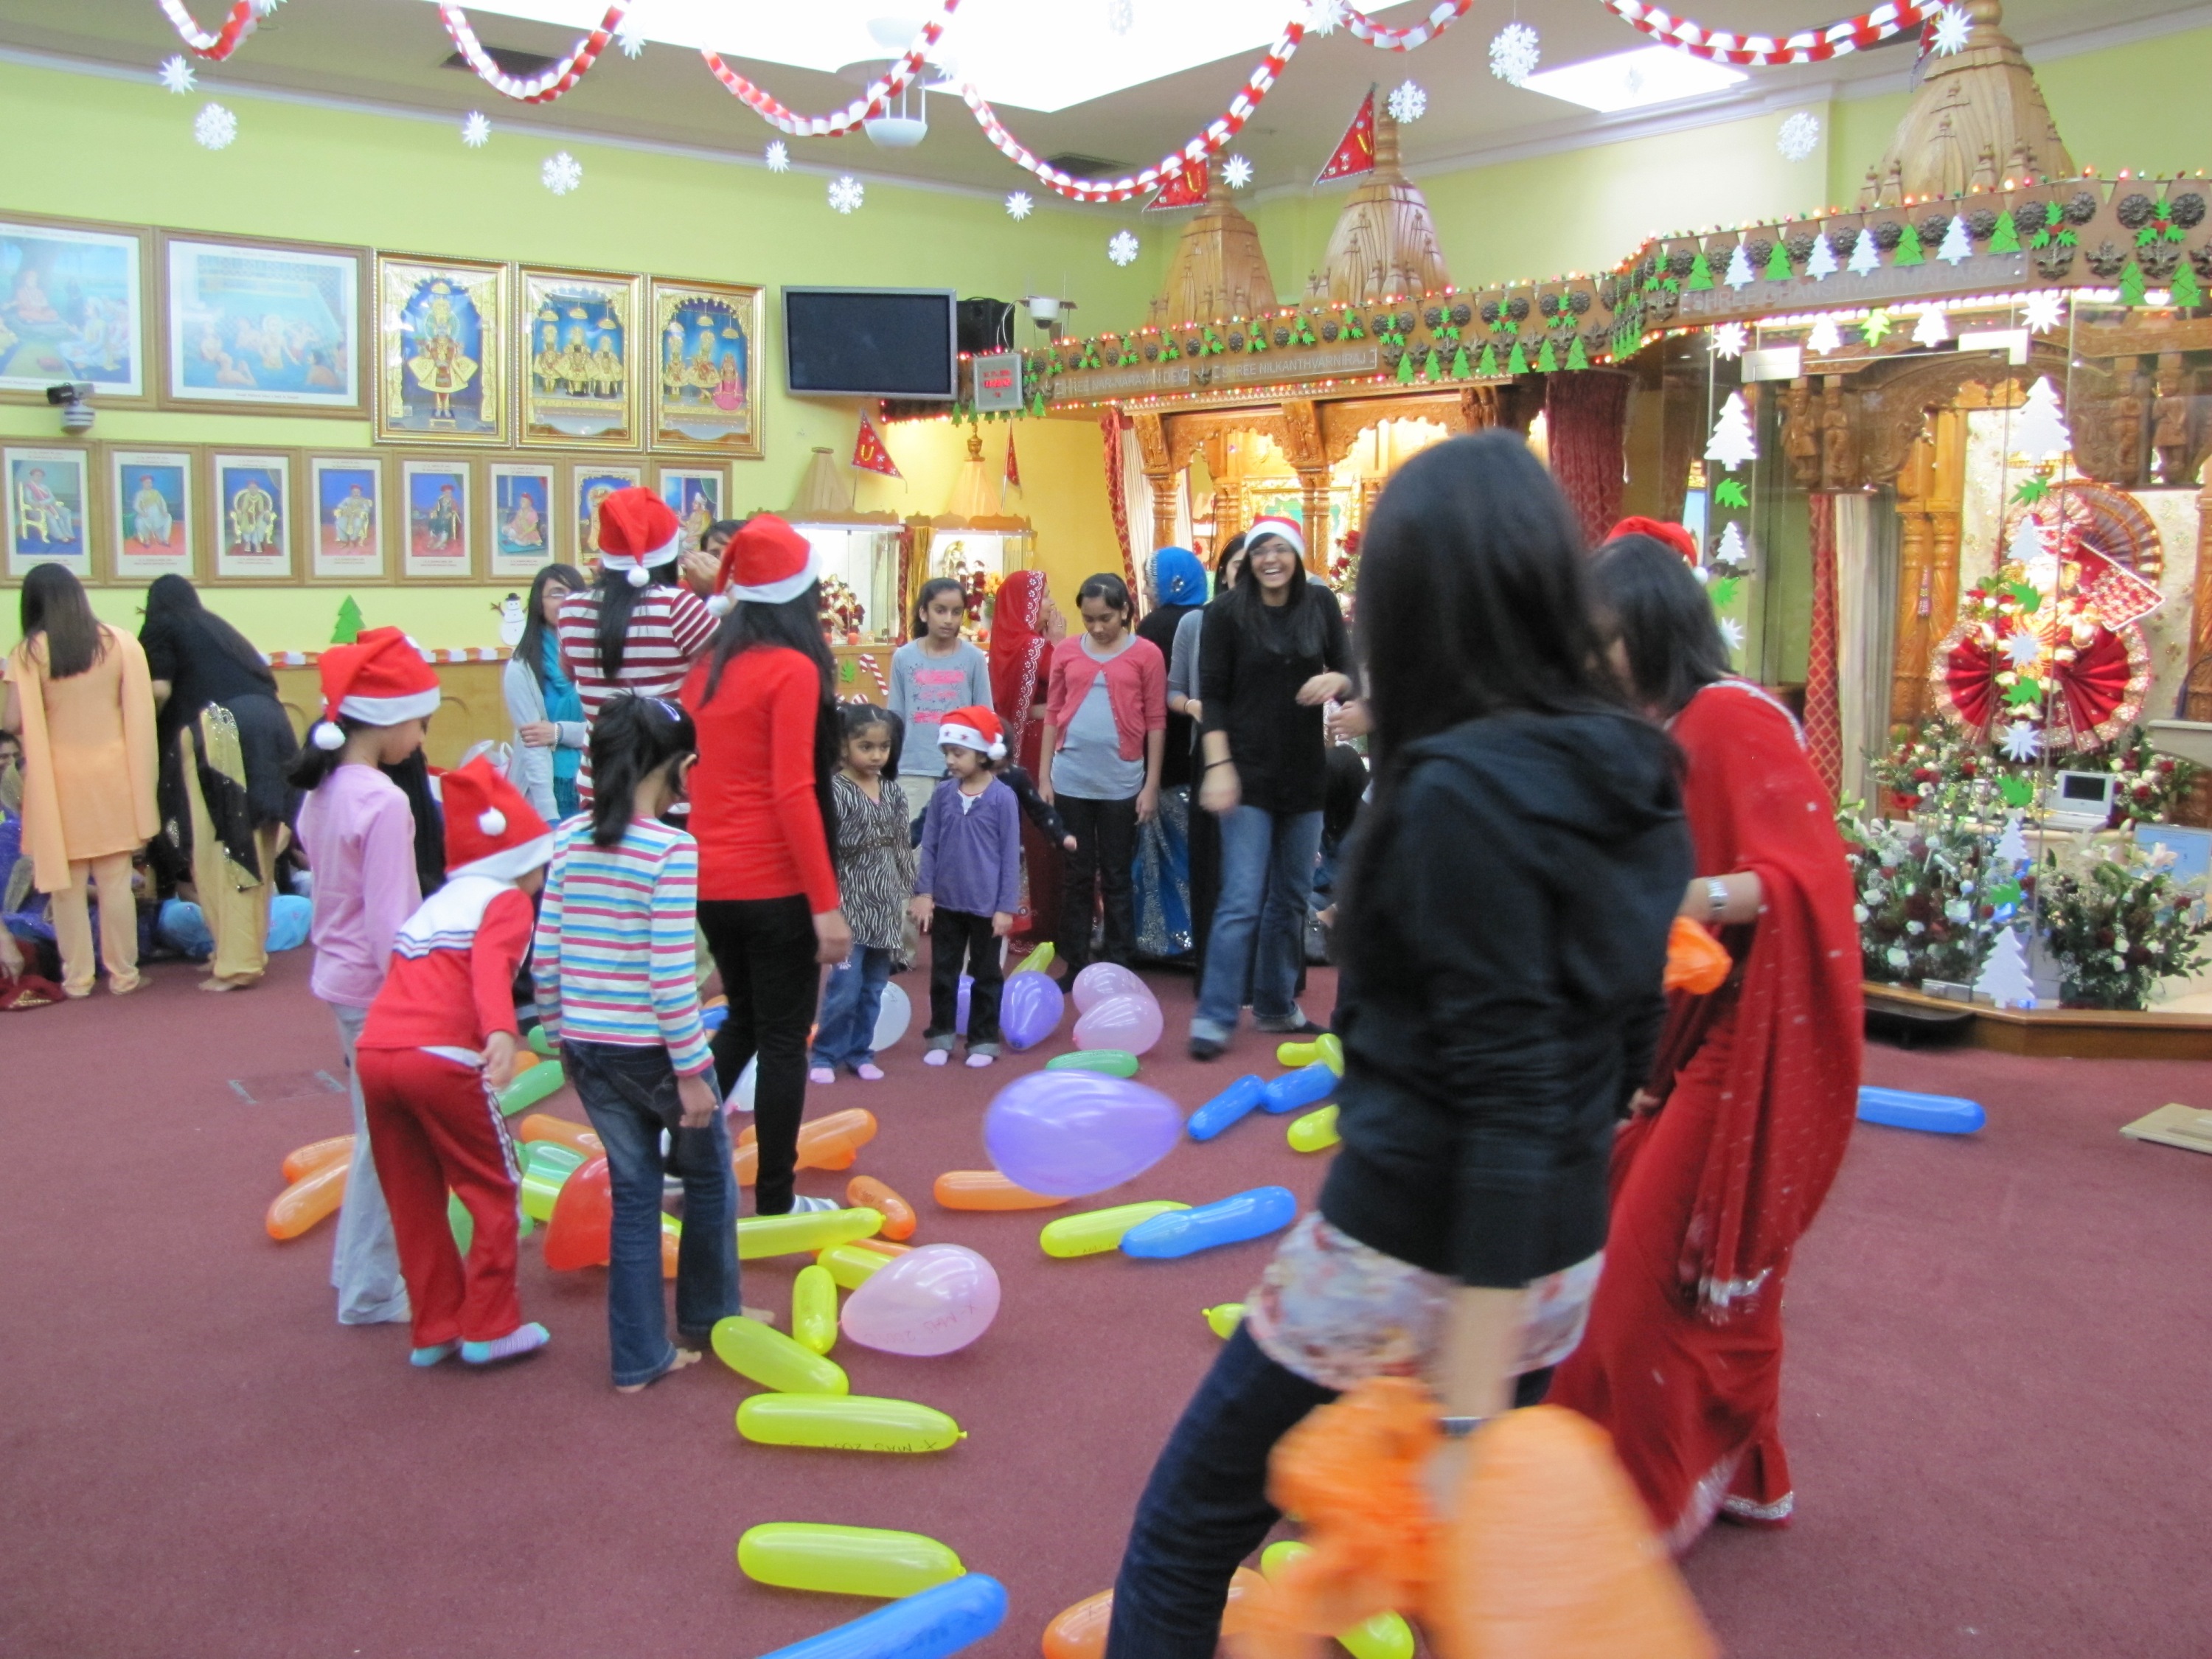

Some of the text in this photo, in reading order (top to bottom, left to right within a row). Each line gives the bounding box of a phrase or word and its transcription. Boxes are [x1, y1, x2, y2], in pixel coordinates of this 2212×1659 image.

[1693, 259, 2011, 310] SHREE GHANSHYAM MAHARAJ
[1222, 352, 1366, 378] SHREE NILKANTHVARNIRAJ
